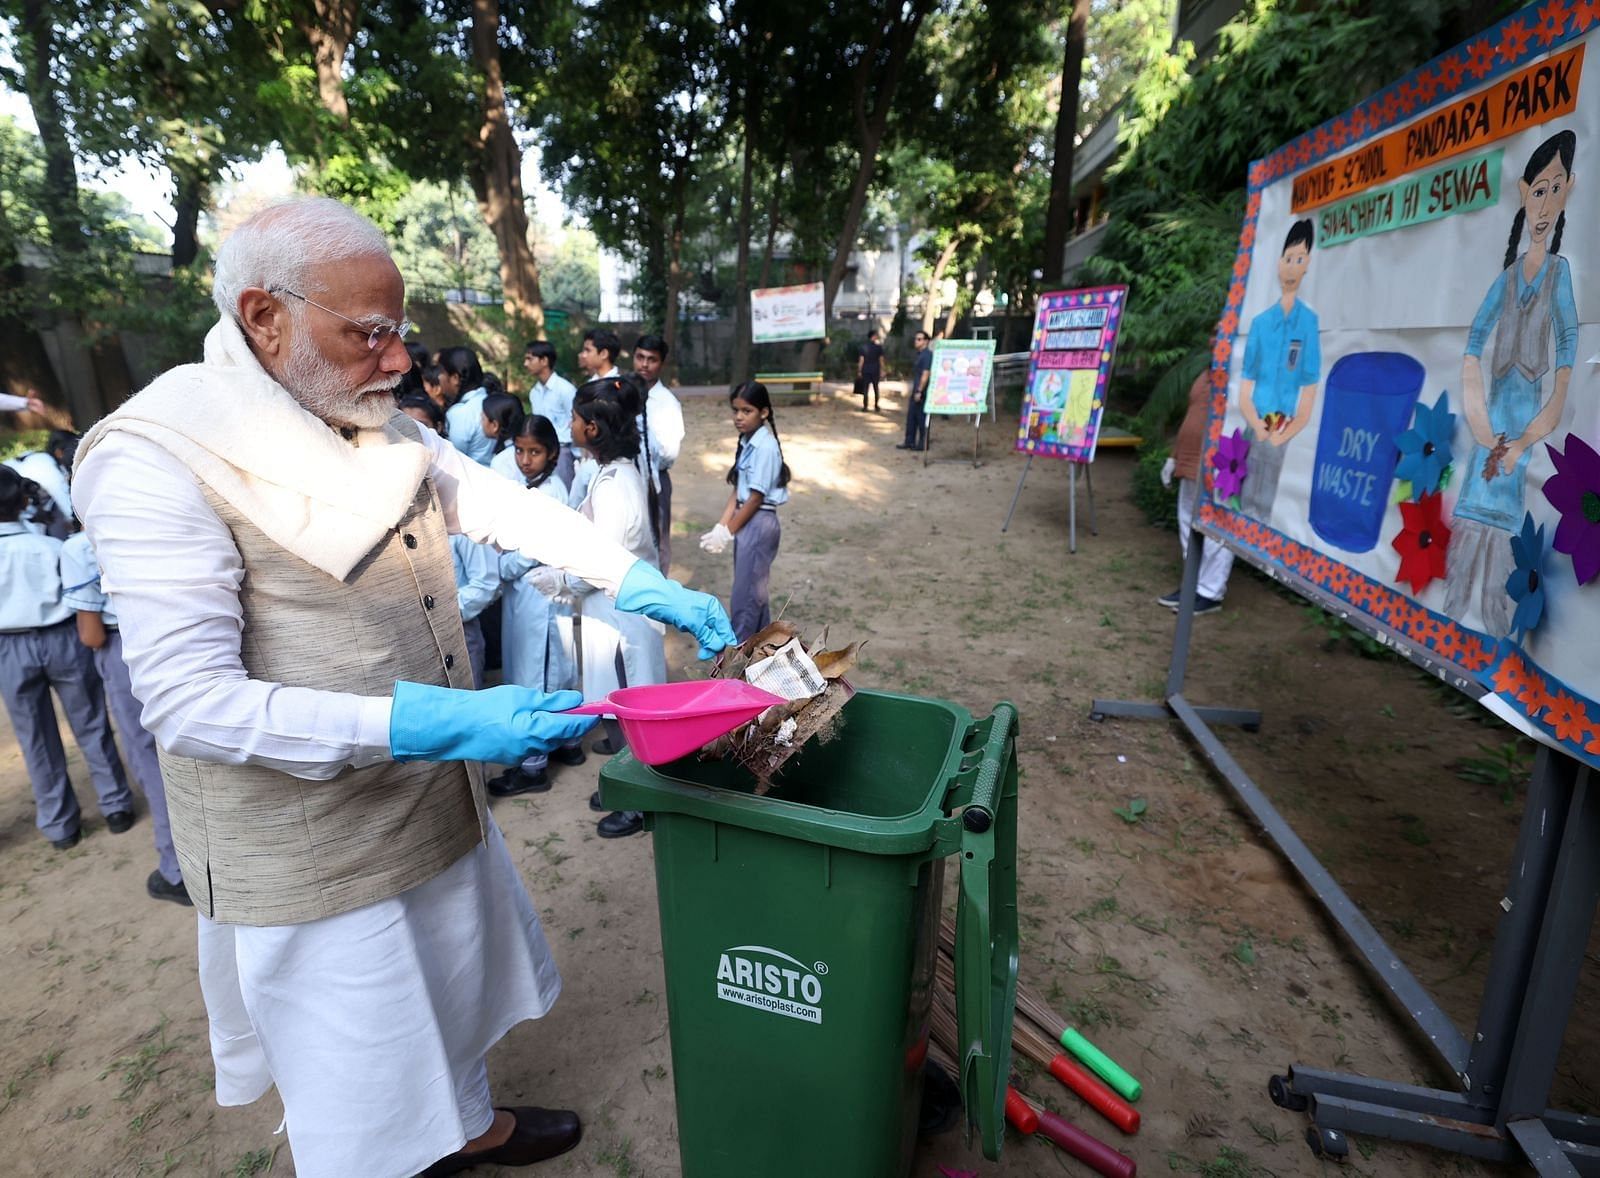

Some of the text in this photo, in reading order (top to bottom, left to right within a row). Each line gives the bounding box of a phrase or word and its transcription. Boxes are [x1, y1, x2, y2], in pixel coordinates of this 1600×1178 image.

[1292, 54, 1576, 212] NAVYUG SCHOOL PANDARA PARK
[1321, 159, 1491, 242] SWACHHTA HI SEWA
[1337, 427, 1380, 462] DRY
[1317, 463, 1376, 506] WASTE
[717, 953, 822, 1004] ARISTO
[722, 987, 817, 1019] www.aristoplast.com
